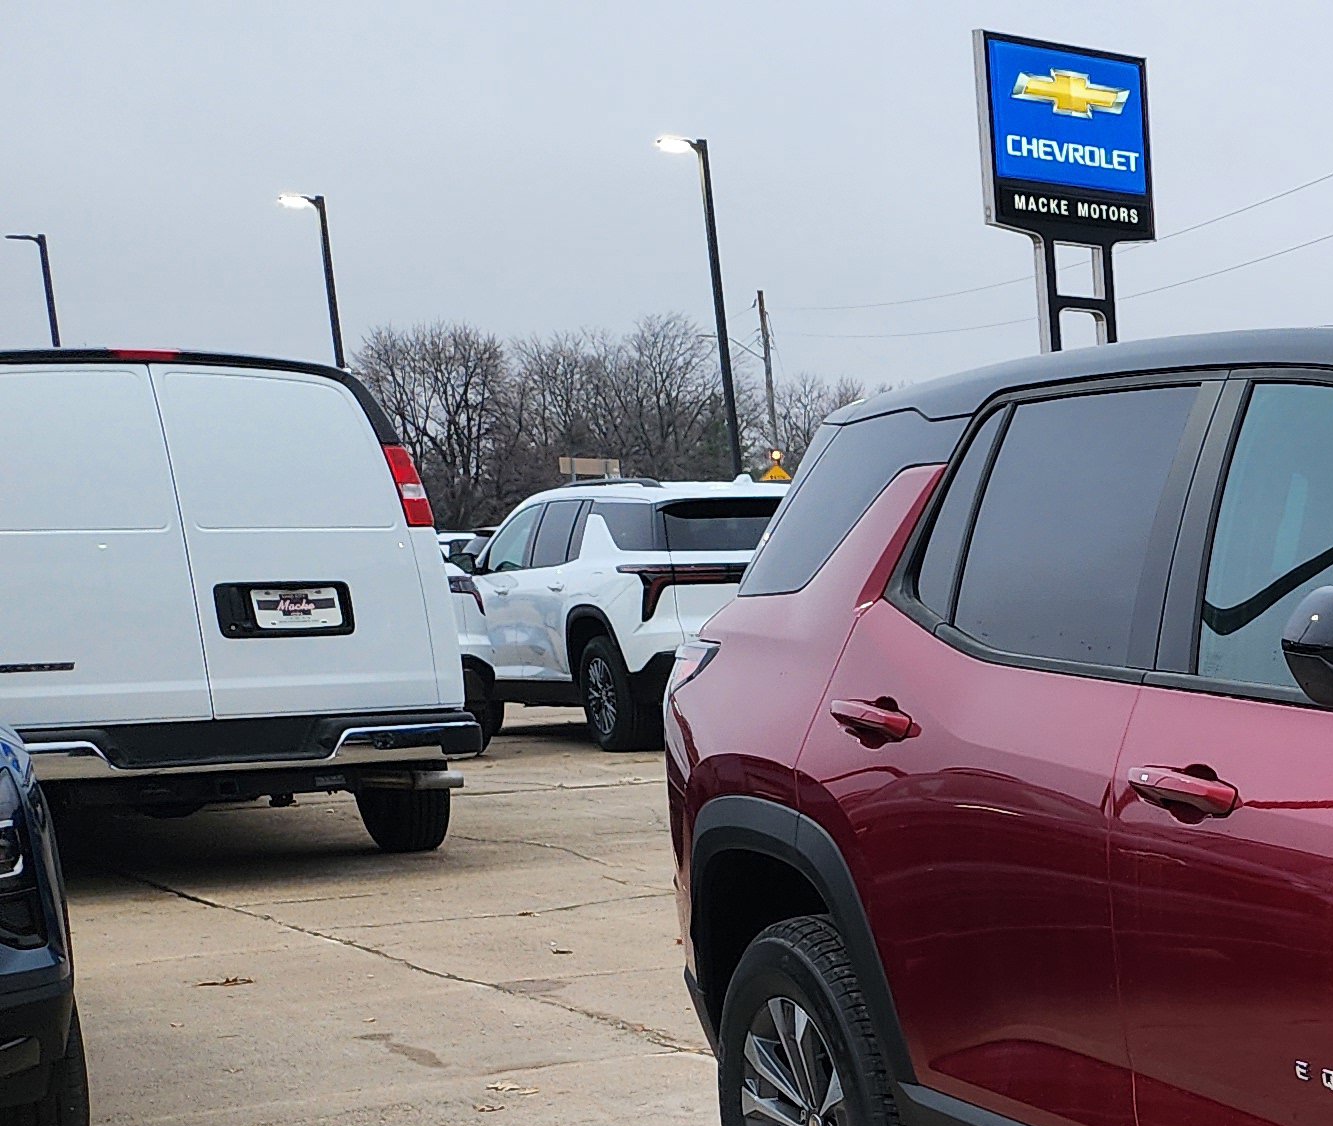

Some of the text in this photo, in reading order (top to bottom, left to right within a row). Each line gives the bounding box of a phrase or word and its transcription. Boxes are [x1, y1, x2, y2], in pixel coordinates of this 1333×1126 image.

[1006, 134, 1140, 172] CHEVROLET
[1014, 193, 1139, 224] MACKE MOTORS
